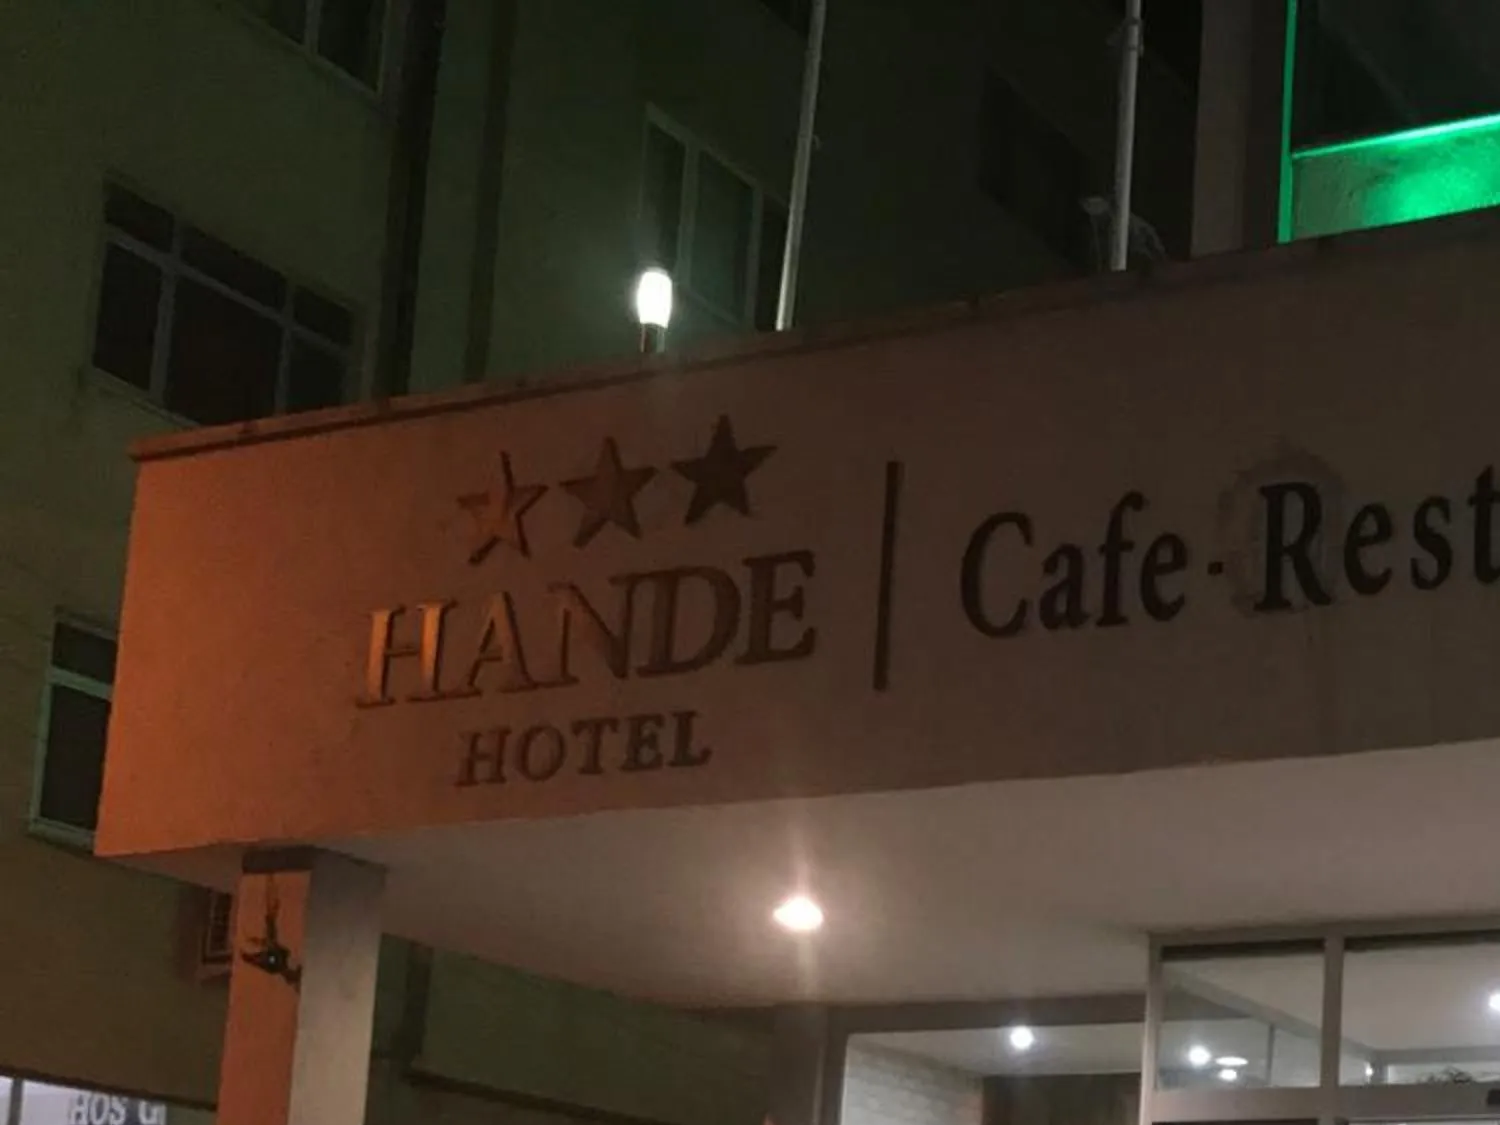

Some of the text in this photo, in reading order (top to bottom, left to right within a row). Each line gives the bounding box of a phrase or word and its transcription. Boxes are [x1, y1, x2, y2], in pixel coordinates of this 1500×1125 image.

[355, 549, 817, 708] HANDE
[958, 491, 1189, 638] Cafe
[454, 711, 711, 787] HOTEL
